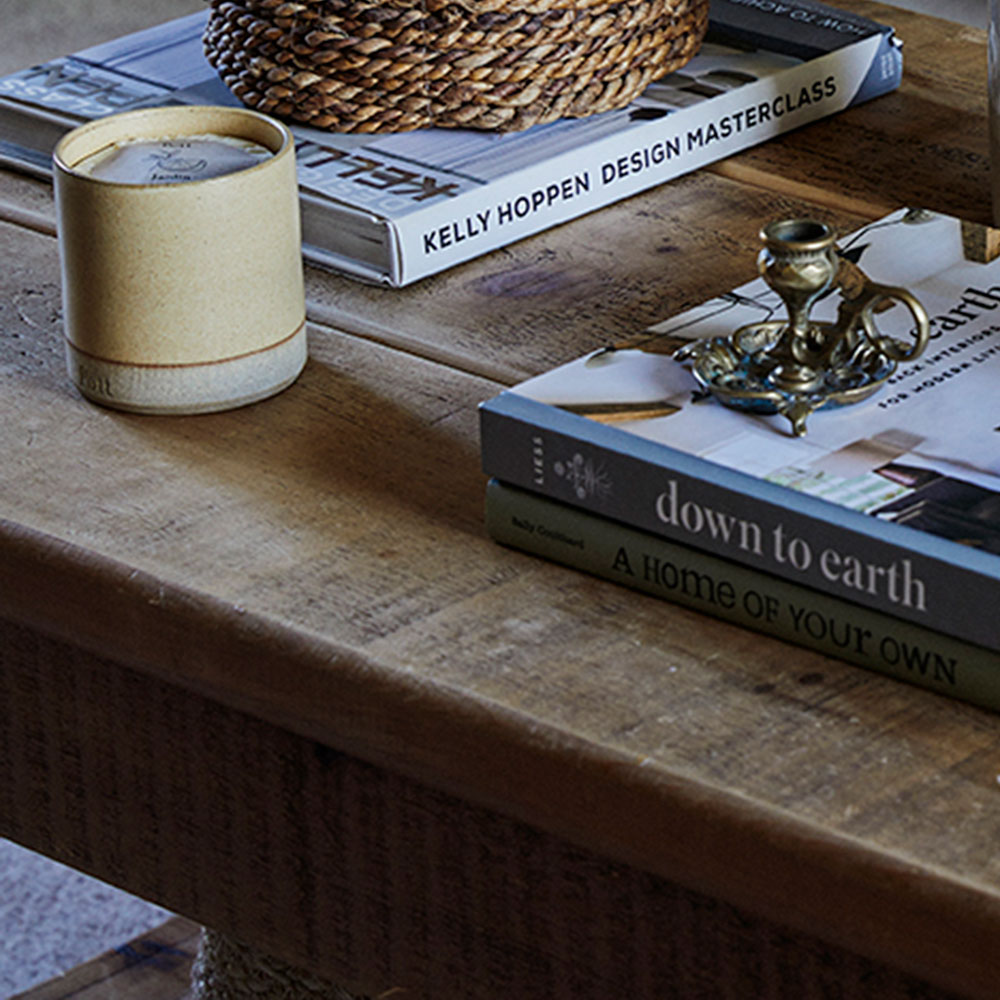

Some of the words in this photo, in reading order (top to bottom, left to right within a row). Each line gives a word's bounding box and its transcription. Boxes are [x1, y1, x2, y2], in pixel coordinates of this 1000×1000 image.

[423, 210, 492, 255] KELLY
[496, 172, 591, 227] HOPPEN
[601, 136, 681, 186] DESIGN
[686, 75, 838, 152] MASTERCLASS
[878, 393, 910, 409] FOR
[911, 362, 973, 393] MODERN
[655, 480, 764, 557] down
[773, 523, 812, 571] to
[820, 548, 928, 613] earth
[611, 546, 636, 577] A
[743, 590, 781, 624] OF
[879, 636, 958, 686] OWN
